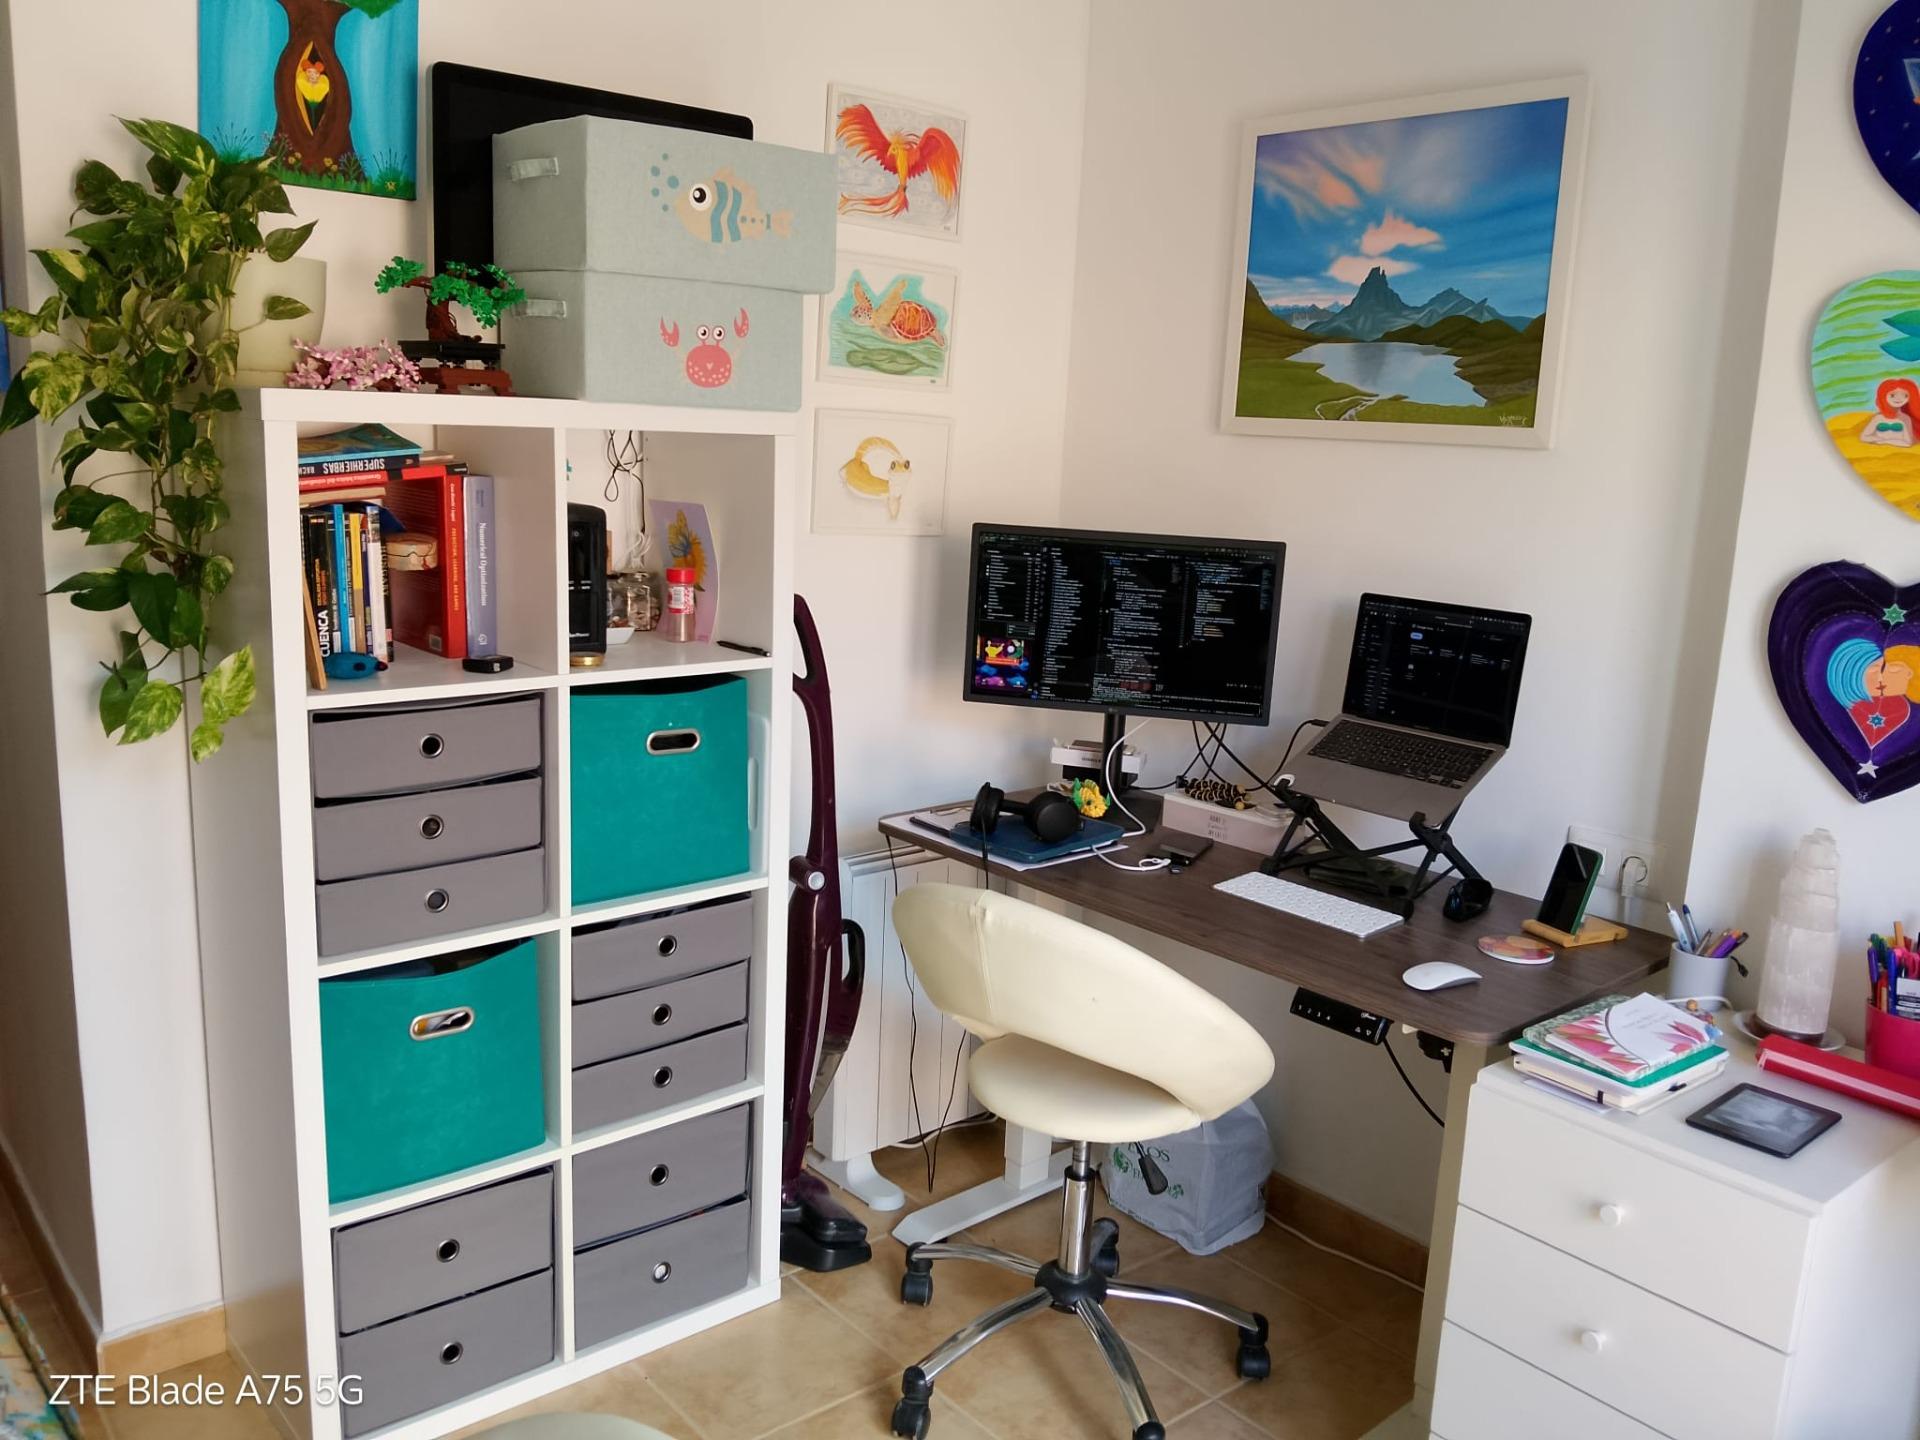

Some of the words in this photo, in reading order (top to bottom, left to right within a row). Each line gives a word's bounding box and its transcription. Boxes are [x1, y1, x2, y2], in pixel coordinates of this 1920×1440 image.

[322, 458, 385, 474] SUPERHIERBAS
[479, 522, 487, 559] Numerical
[478, 560, 488, 606] Optimization
[318, 610, 330, 657] CUENCA
